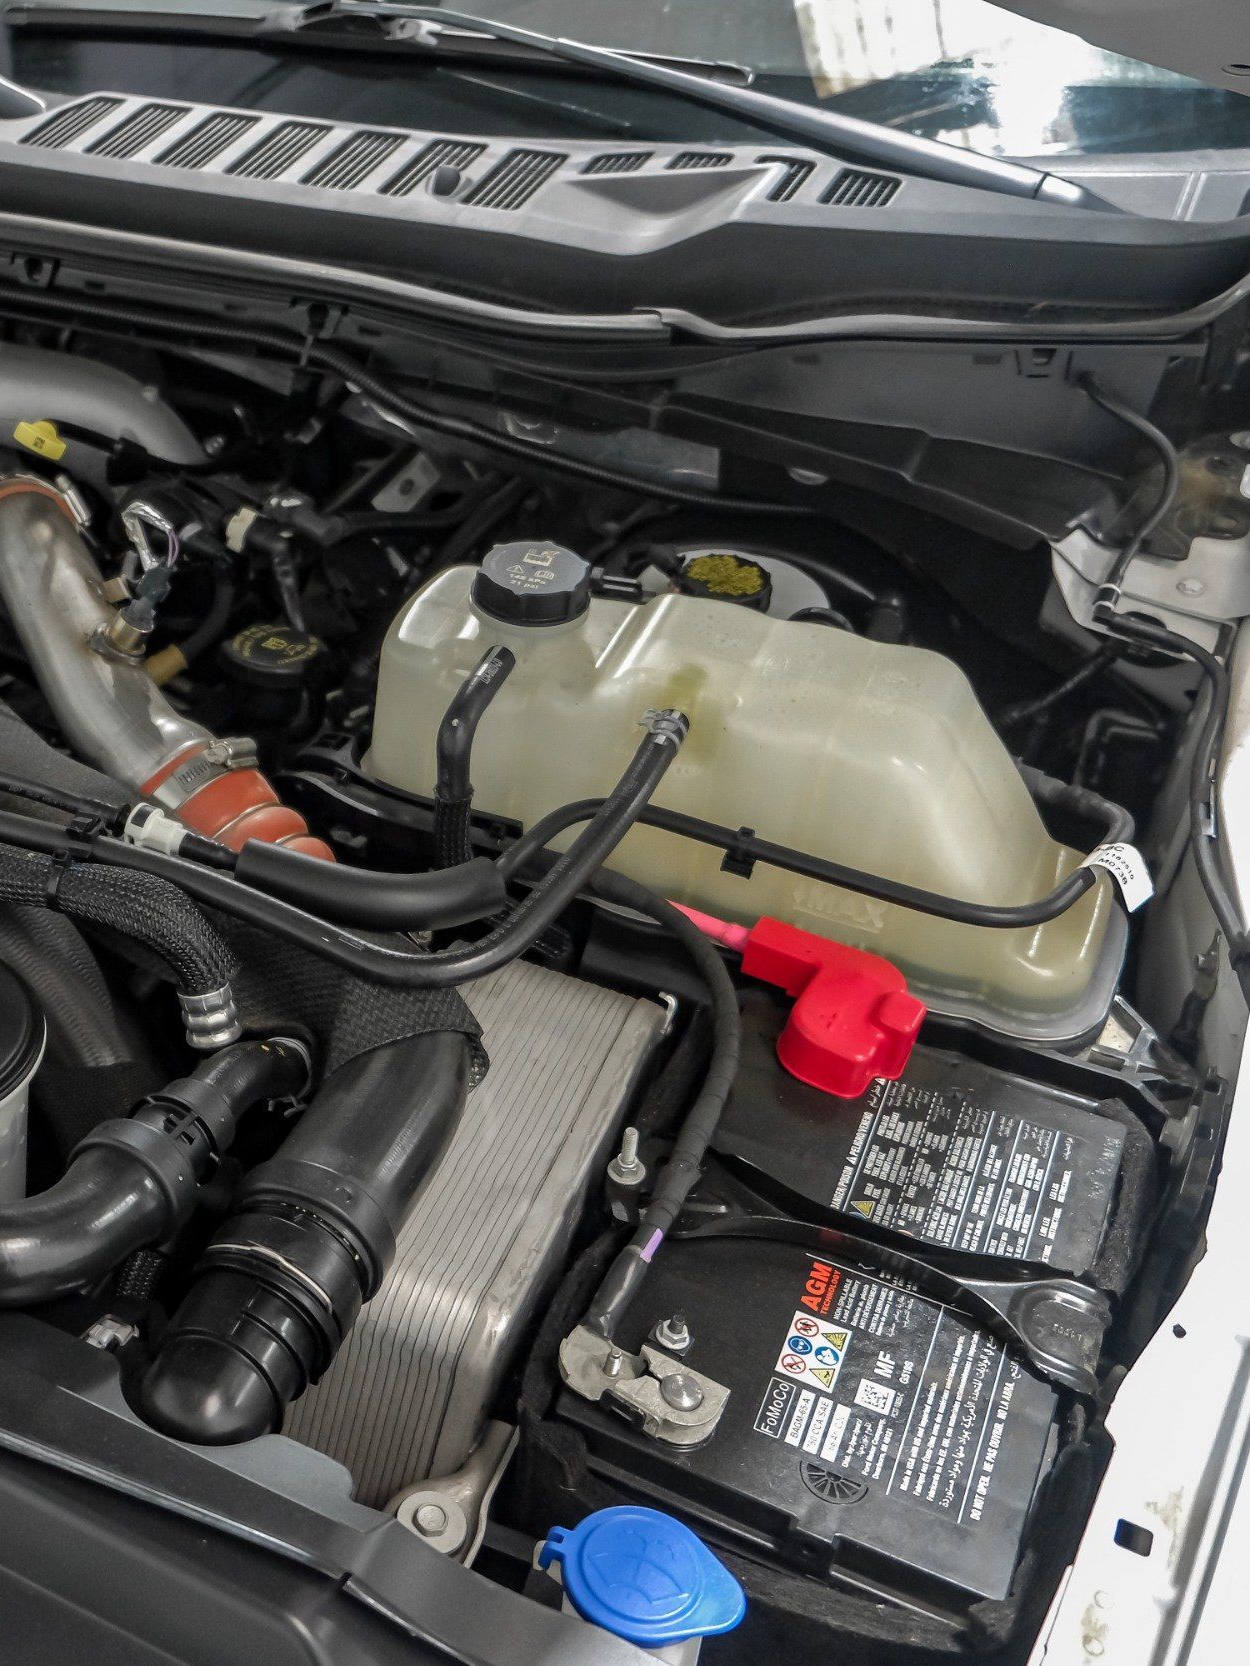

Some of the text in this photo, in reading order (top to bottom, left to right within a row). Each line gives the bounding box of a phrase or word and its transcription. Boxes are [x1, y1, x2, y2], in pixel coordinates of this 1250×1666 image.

[801, 1262, 831, 1310] AGM
[820, 1270, 839, 1313] TECHNOLOGY
[840, 1280, 860, 1322] Lead Acid Battery
[874, 1351, 895, 1377] MF
[998, 1400, 1009, 1410] LA
[1001, 1382, 1014, 1401] ABRA.
[760, 1383, 789, 1433] FoMoCo
[789, 1396, 810, 1439] BAGM-65-A
[811, 1417, 823, 1435] CCA
[817, 1400, 829, 1417] SAE
[996, 1409, 1007, 1419] NO
[861, 1461, 871, 1475] Ford
[866, 1445, 876, 1461] Motor
[982, 1461, 993, 1472] NE
[985, 1447, 997, 1462] PAS
[972, 1494, 984, 1509] NOT
